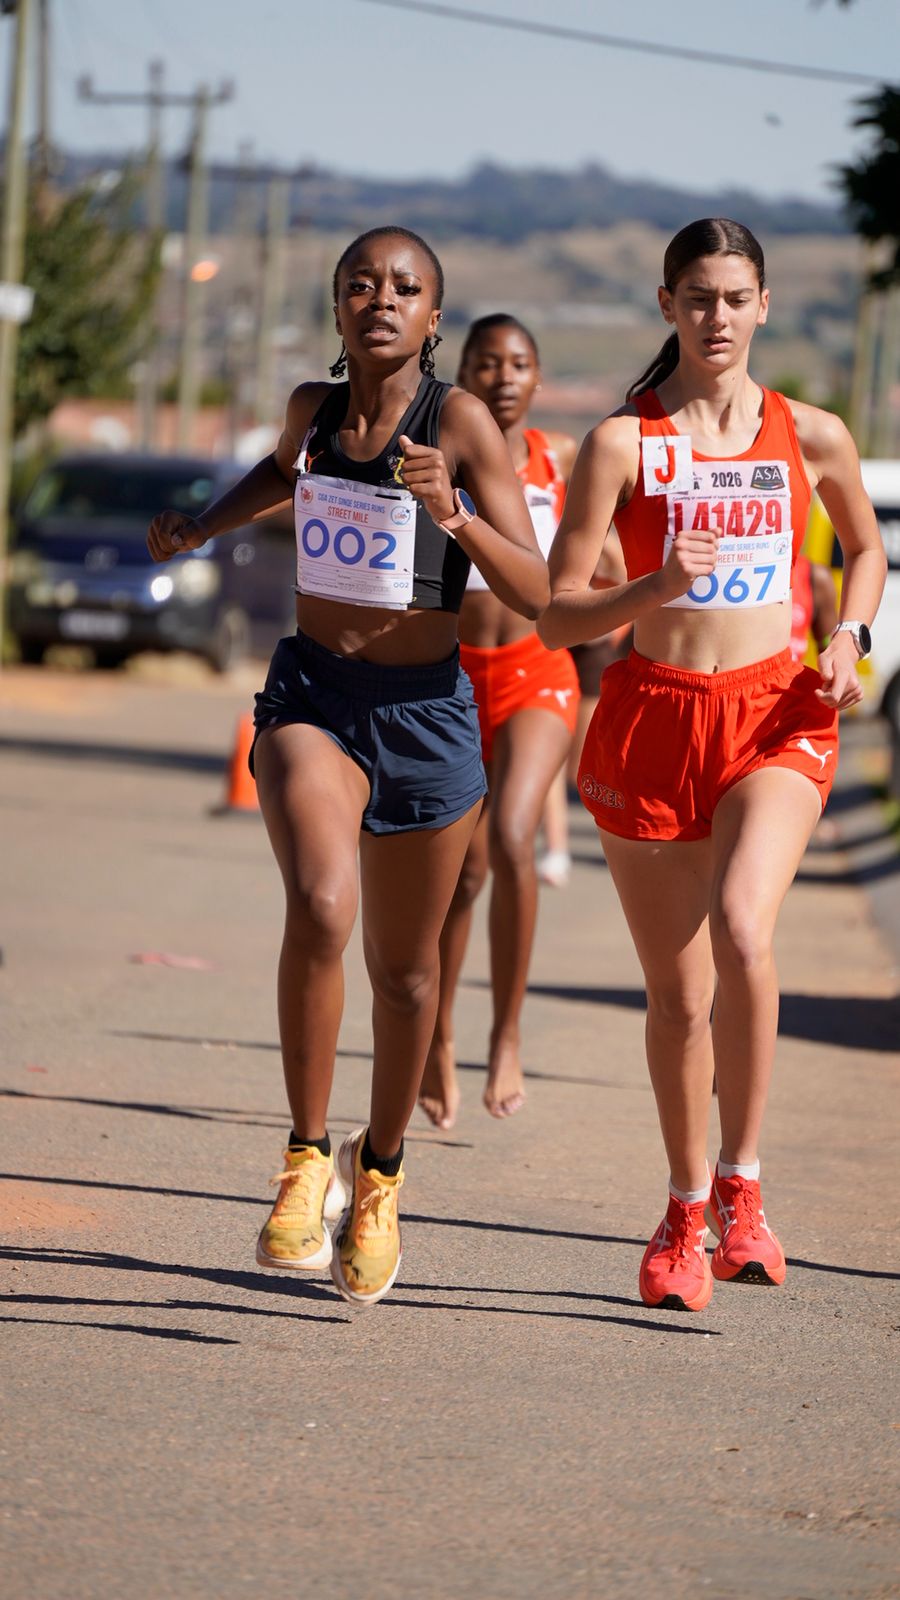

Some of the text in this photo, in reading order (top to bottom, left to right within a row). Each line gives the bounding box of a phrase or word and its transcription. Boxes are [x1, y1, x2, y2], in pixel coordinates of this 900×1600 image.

[654, 445, 675, 484] J
[711, 471, 742, 488] 2026
[754, 468, 781, 481] ASA
[327, 506, 369, 523] STREET MILE
[302, 518, 397, 570] 002
[737, 552, 754, 562] MILE
[687, 564, 776, 604] 067
